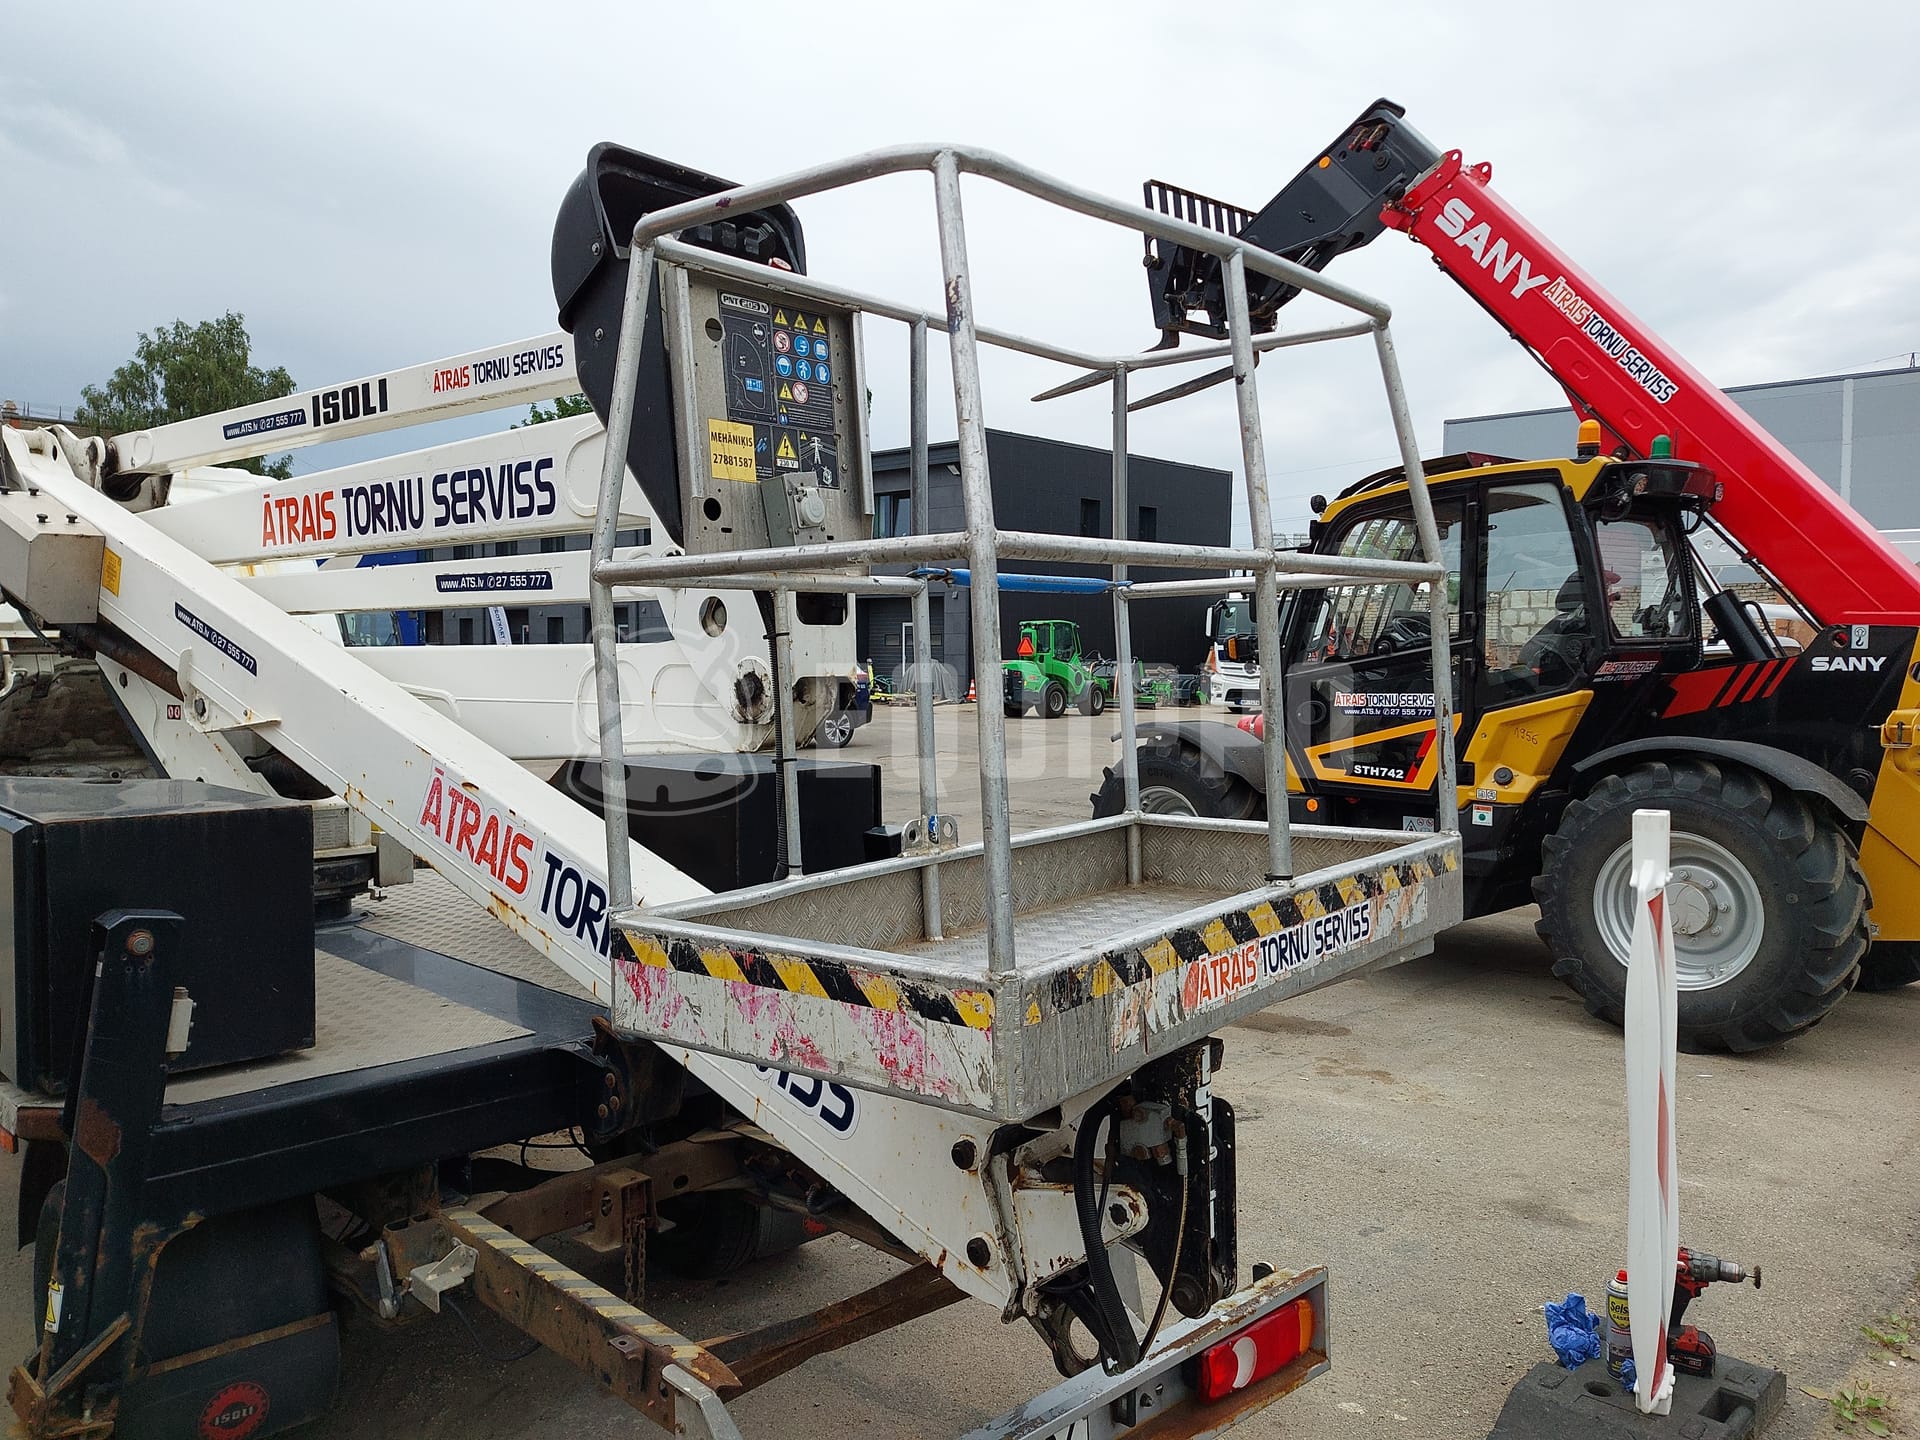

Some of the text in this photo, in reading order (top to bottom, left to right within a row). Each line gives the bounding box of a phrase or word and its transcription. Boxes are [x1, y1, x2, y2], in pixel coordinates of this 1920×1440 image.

[1434, 198, 1550, 299] SANY
[722, 295, 739, 306] PNT
[760, 303, 768, 312] N
[1583, 313, 1628, 357] TORNU
[1619, 349, 1677, 402] SERVISS
[433, 344, 564, 394] ĀTRAIS TORNU SERVISS
[311, 378, 389, 428] ISOLI
[226, 412, 303, 438] www.ATS.lv 27 555 777
[711, 431, 753, 449] MEHĀNIĶIS
[713, 453, 753, 469] 27881587
[262, 457, 556, 548] ĀTRAIS TORNU SERVISS
[440, 574, 547, 589] www.ATS.lv 27 555 777
[177, 609, 255, 670] www.ATS.lv 27 555 777
[1811, 656, 1887, 672] SANY
[1367, 693, 1398, 706] TORNU
[1399, 693, 1435, 707] SERVIS
[1344, 707, 1381, 716] www.ATS.lv
[1402, 708, 1416, 716] 555
[1418, 708, 1432, 716] 777
[1354, 764, 1404, 779] STH742
[420, 767, 534, 895] ĀTRAIS
[1199, 903, 1371, 1004] ĀTRAIS TORNU SERVISS
[1610, 1301, 1629, 1314] Sels
